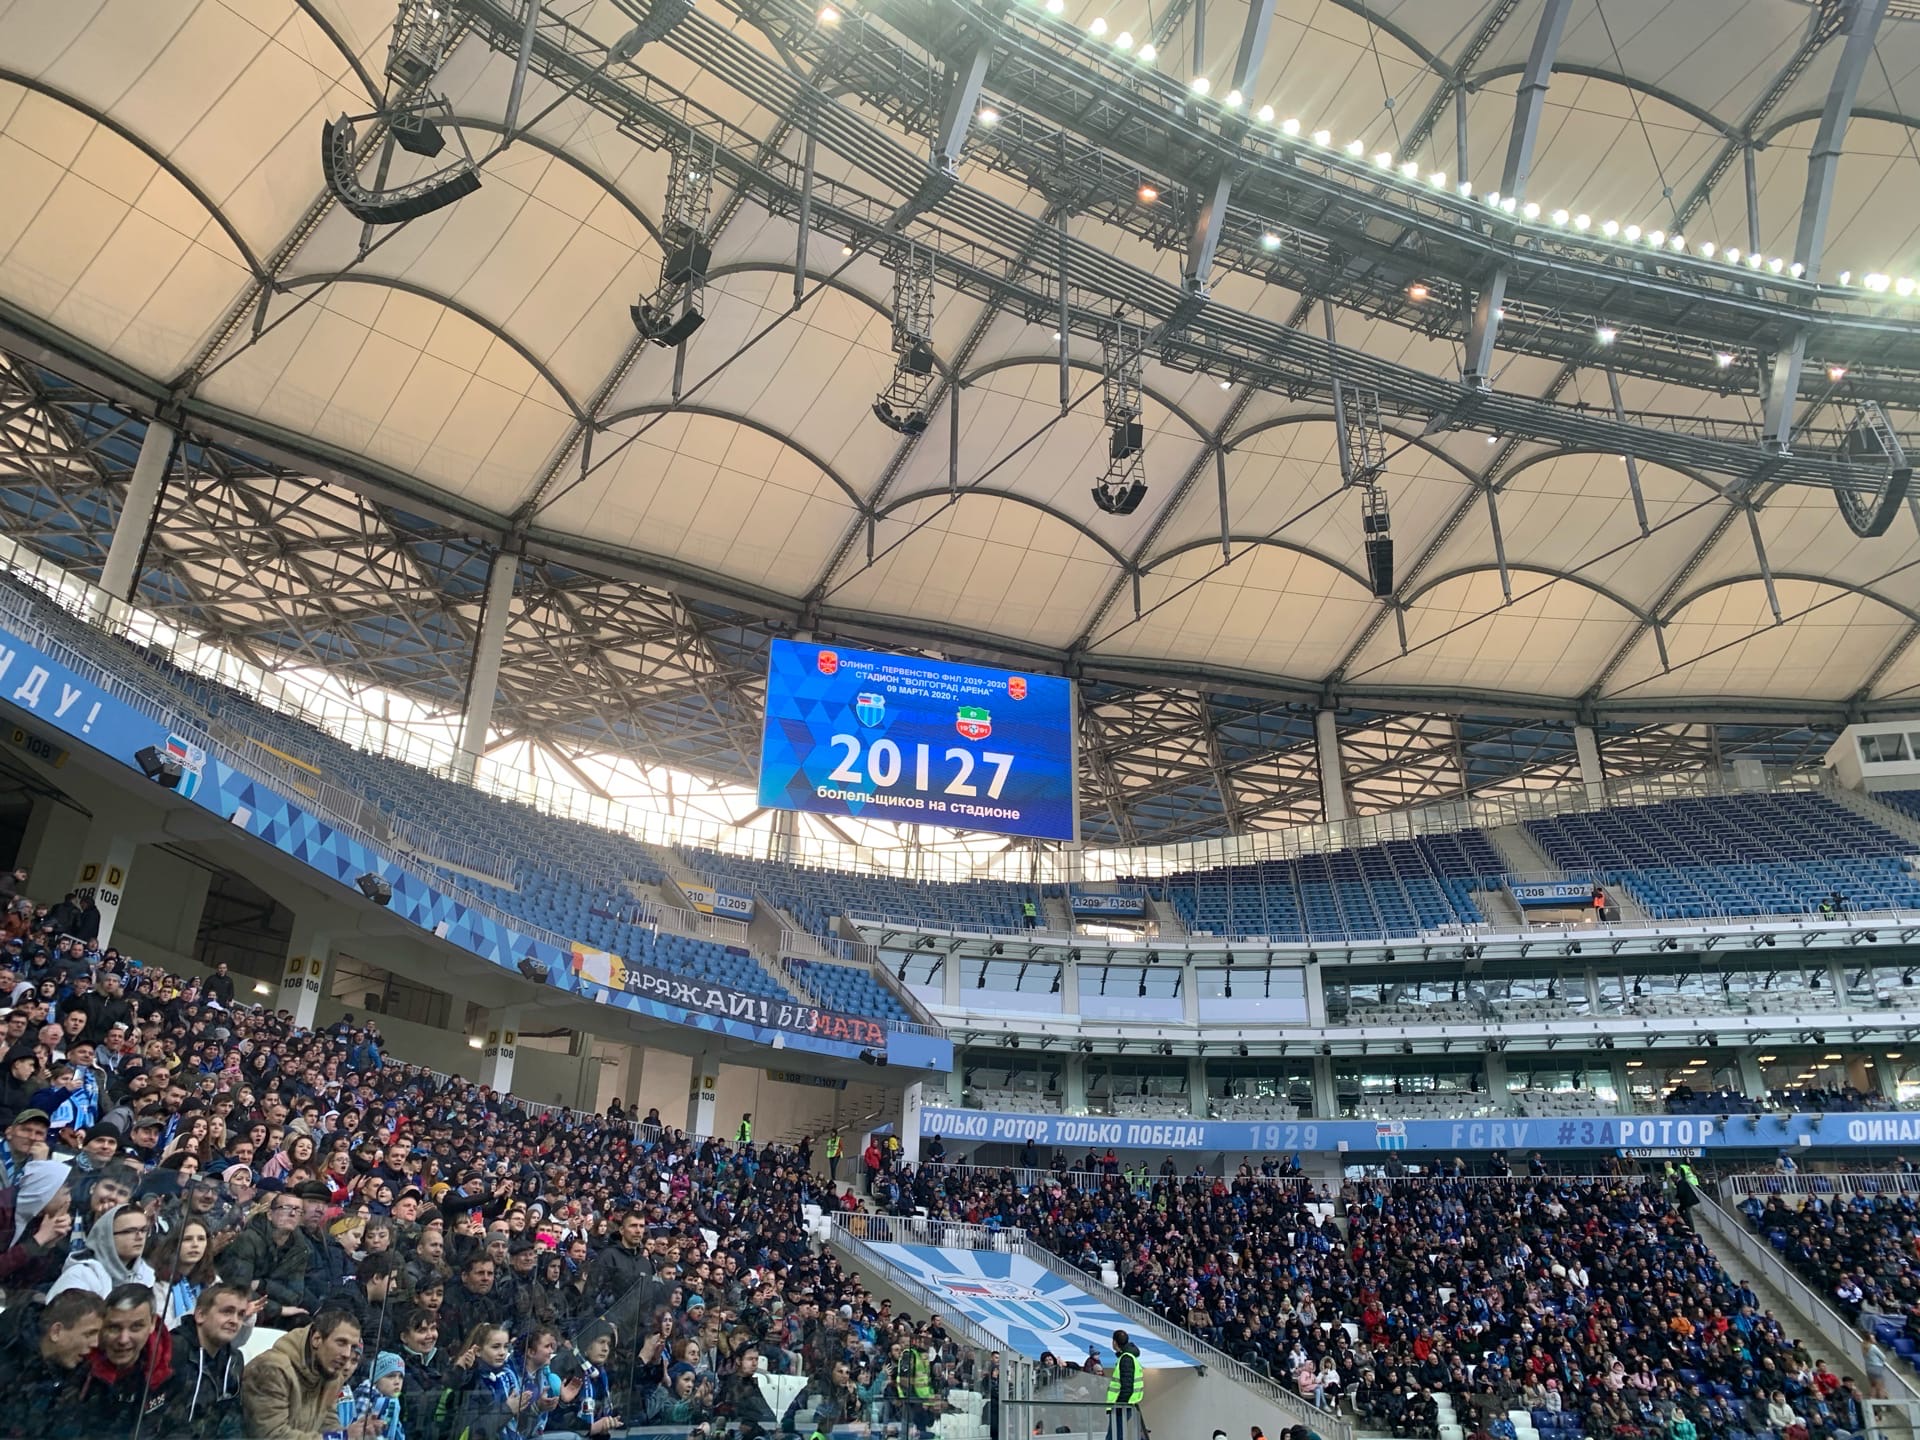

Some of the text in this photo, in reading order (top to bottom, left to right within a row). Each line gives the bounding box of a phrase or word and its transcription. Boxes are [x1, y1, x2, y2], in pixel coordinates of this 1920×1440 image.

[840, 660, 874, 671] ОЛИМП
[882, 665, 940, 680] ПЕРВЕНСТВО
[942, 674, 962, 683] ФНЛ
[963, 676, 1007, 689] 2019-2020
[855, 671, 899, 684] СТАДИОН
[887, 684, 897, 693] 09
[899, 686, 930, 697] МАРТА
[931, 691, 951, 700] 2020
[827, 733, 1015, 800] 20127
[817, 785, 1020, 820] болельщиков на стадионе
[83, 865, 96, 881] D
[109, 867, 121, 885] D
[100, 889, 119, 906] 108
[687, 891, 704, 902] 210
[1526, 888, 1545, 897] 208
[1568, 886, 1585, 896] 207
[728, 899, 746, 910] 209
[1083, 898, 1100, 907] 209
[284, 978, 303, 988] 108
[306, 979, 319, 993] 108
[619, 967, 768, 1024] ЗАРЯЖАЙ!
[505, 1032, 513, 1044] D
[500, 1048, 514, 1059] 108
[705, 1077, 713, 1089] D
[702, 1092, 715, 1102] 108
[923, 1112, 1204, 1148] ТОЛЬКО РОТОР, ТОЛЬКО ПОБЕДА!
[1451, 1122, 1529, 1148] FCRV
[1249, 1125, 1318, 1150] 1929
[1637, 1149, 1652, 1157] 107
